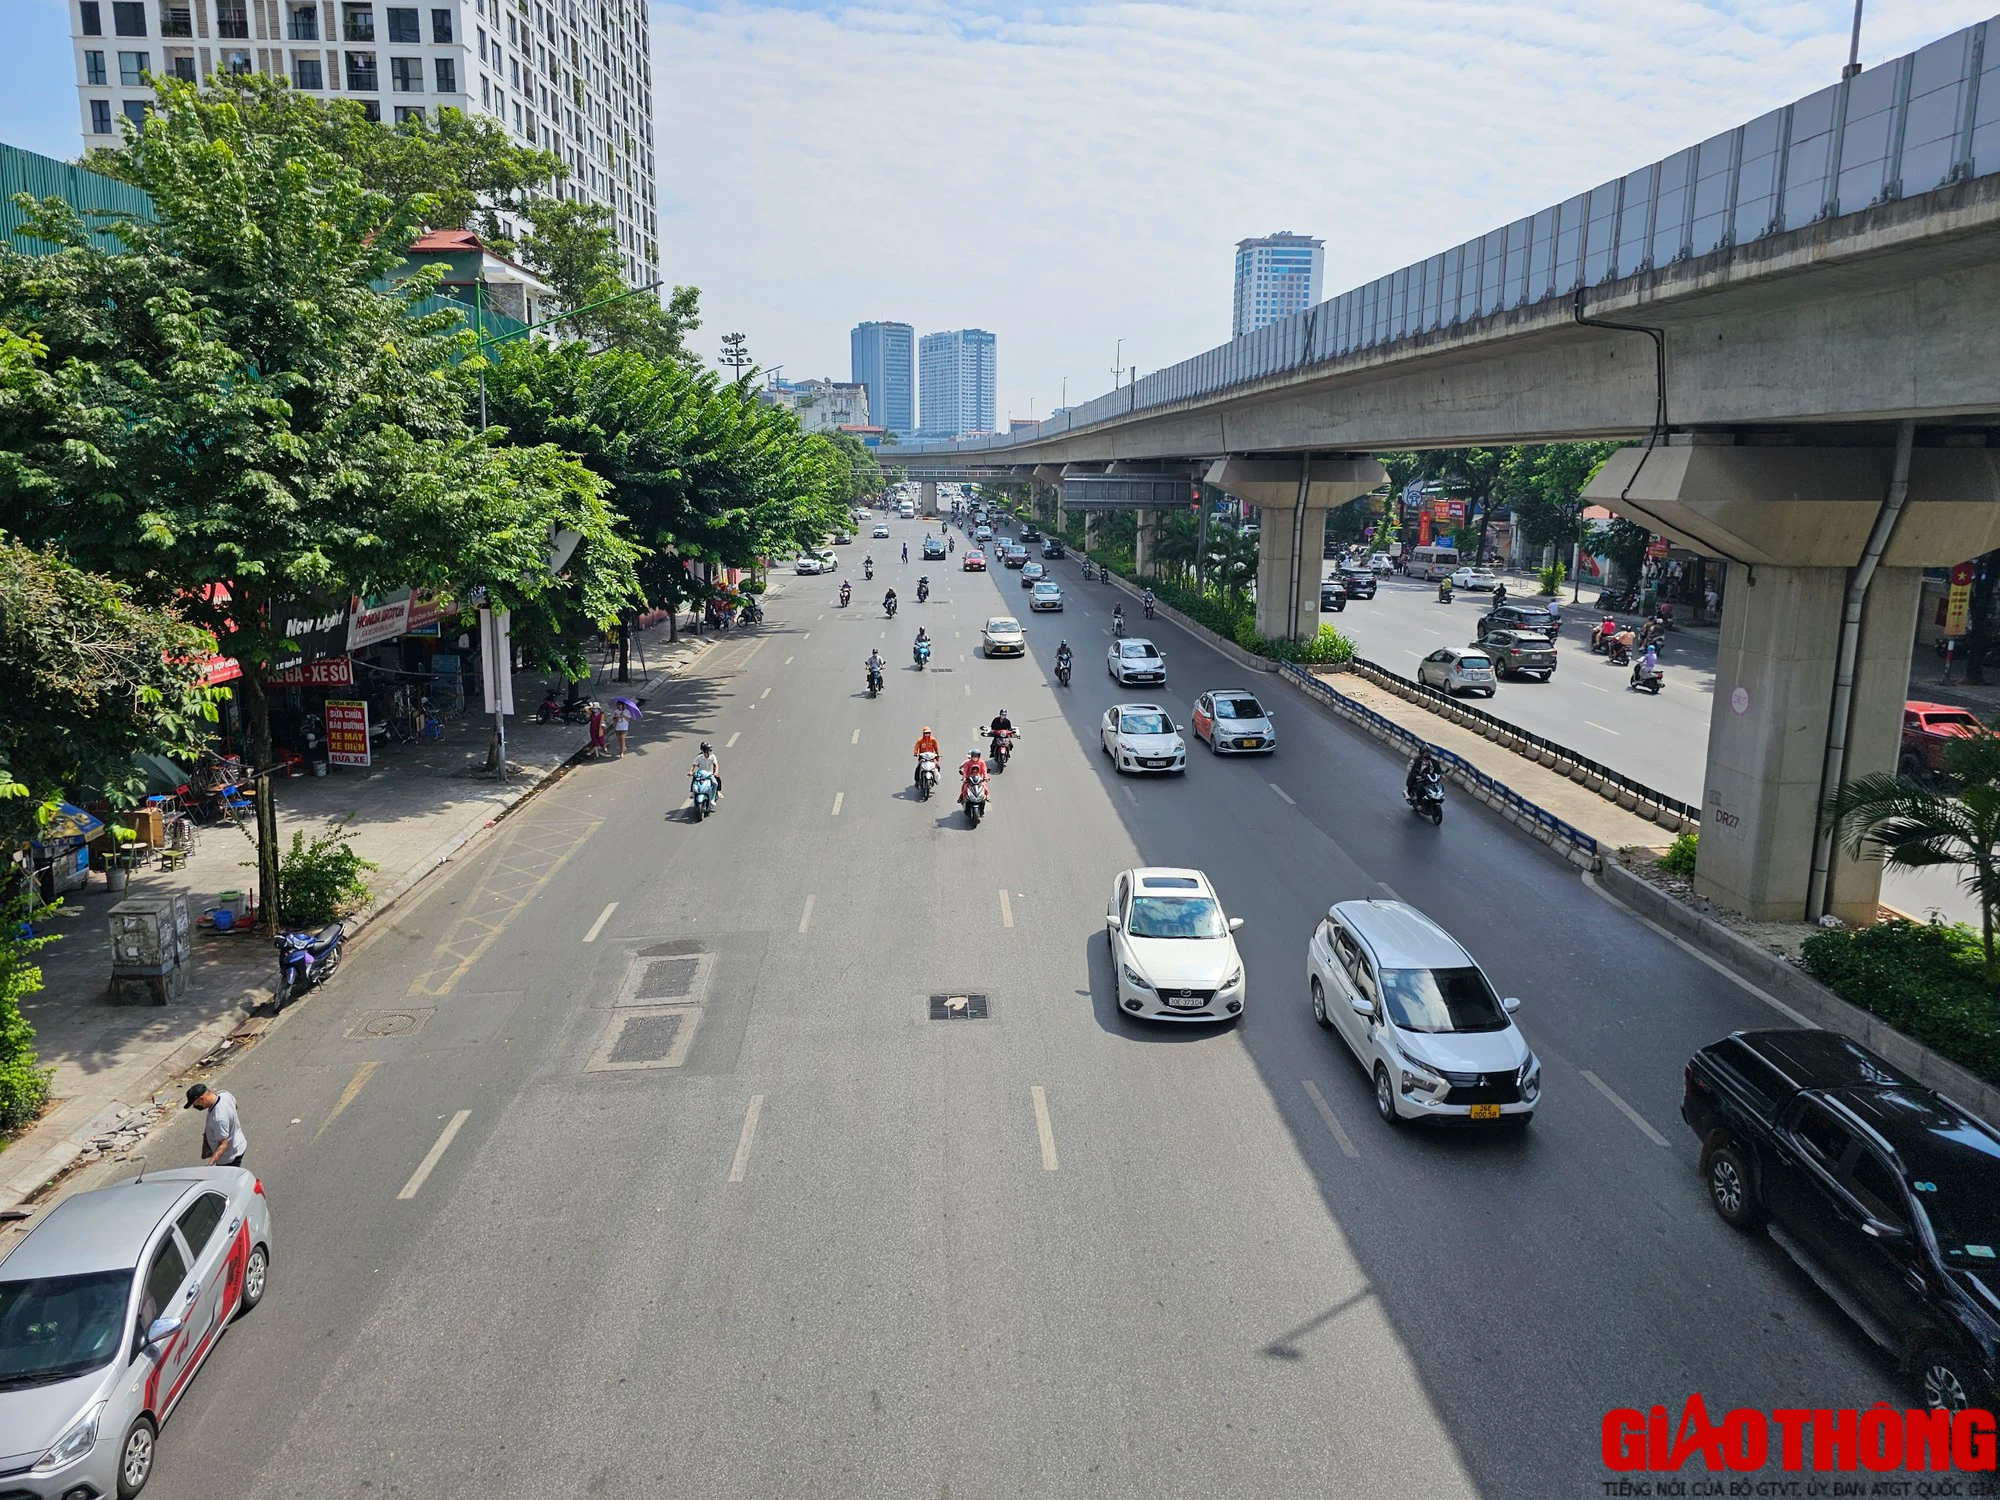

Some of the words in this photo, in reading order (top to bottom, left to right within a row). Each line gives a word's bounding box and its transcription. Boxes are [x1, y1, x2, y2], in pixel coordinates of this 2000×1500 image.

[286, 618, 315, 638] New
[315, 608, 345, 633] Light
[311, 665, 329, 682] XE
[331, 732, 342, 740] XE
[331, 742, 342, 750] XE
[353, 755, 366, 763] XE
[1715, 808, 1740, 829] DR27
